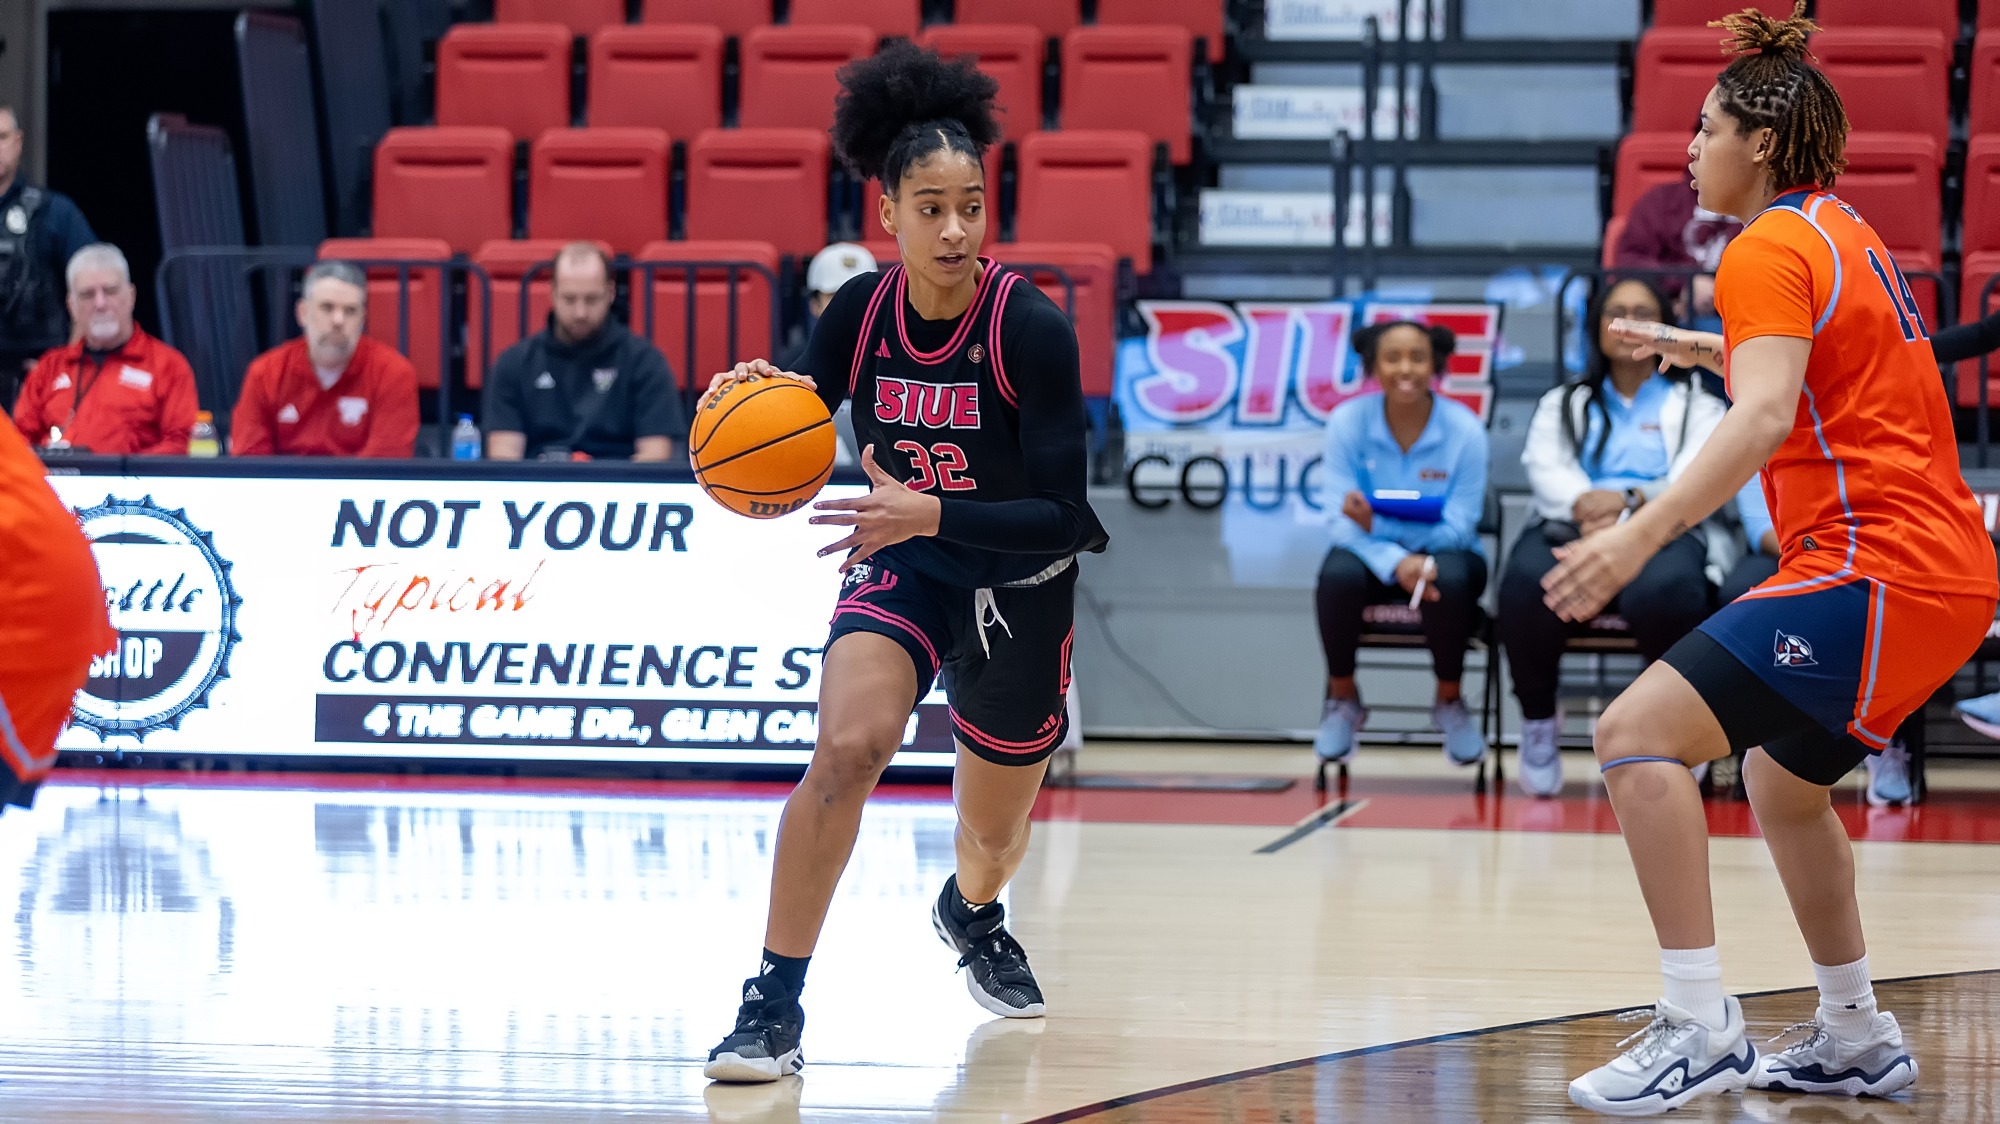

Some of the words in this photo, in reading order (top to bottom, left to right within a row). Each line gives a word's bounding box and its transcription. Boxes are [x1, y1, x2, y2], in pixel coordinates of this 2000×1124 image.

[1865, 247, 1930, 342] 14
[874, 375, 981, 430] SIUE
[894, 440, 977, 491] 32
[331, 499, 480, 549] NOT
[504, 500, 694, 552] YOUR
[332, 558, 545, 640] Typical
[323, 640, 758, 689] CONVENIENCE
[363, 703, 391, 736] 4
[395, 703, 466, 737] THE
[469, 704, 577, 739] GAME
[661, 708, 762, 743] GLEN
